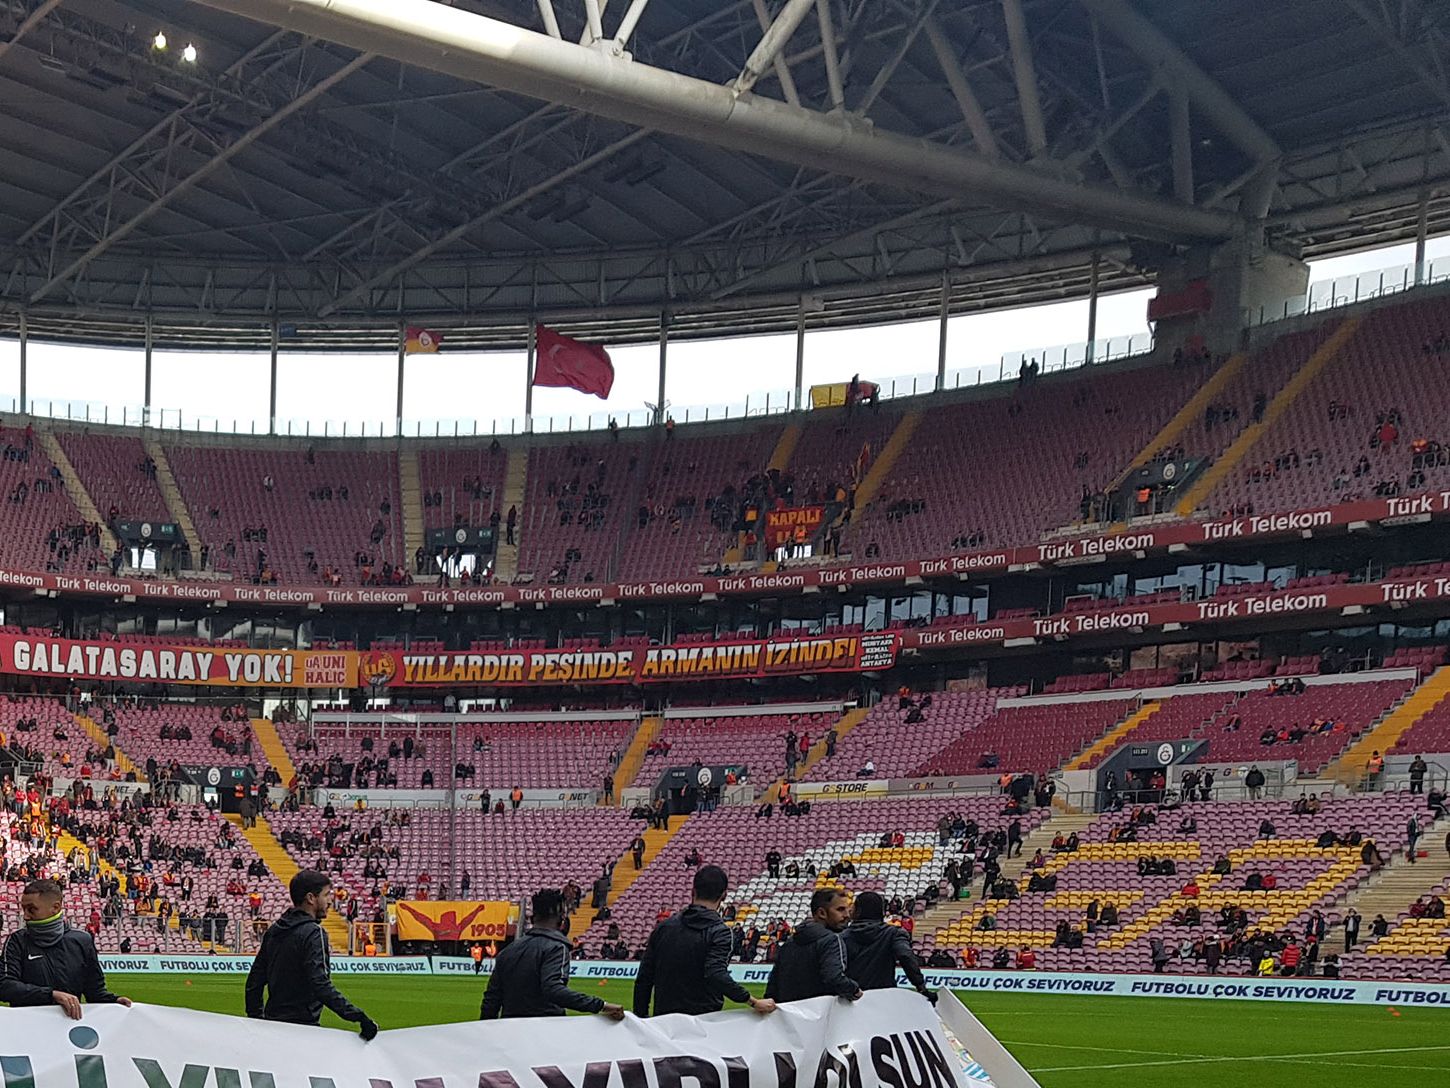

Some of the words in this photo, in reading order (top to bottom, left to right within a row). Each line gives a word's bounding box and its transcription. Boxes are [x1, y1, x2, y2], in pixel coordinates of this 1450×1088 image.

[1386, 494, 1434, 517] Türk
[1202, 519, 1242, 541] Türk
[1249, 510, 1332, 534] Telekom
[1038, 542, 1074, 561] Türk
[1080, 533, 1154, 556] Telekom
[919, 559, 947, 573] Türk
[951, 553, 1007, 571] Telekom
[819, 569, 848, 583] Türk
[850, 564, 905, 581] Telekom
[55, 576, 81, 590] Türk
[83, 578, 131, 594] Telekom
[143, 583, 169, 596] Türk
[171, 585, 221, 599] Telekom
[618, 583, 646, 597] Türk
[649, 581, 704, 595] Telekom
[718, 577, 746, 591] Türk
[749, 574, 805, 589] Telekom
[1381, 580, 1427, 601] Türk
[234, 587, 261, 600] Türk
[264, 589, 314, 602] Telekom
[327, 590, 353, 602] Türk
[356, 590, 408, 603] Telekom
[422, 590, 449, 603] Türk
[452, 589, 505, 602] Telekom
[518, 588, 546, 601] Türk
[549, 586, 603, 600] Telekom
[1198, 600, 1238, 620] Türk
[1244, 592, 1327, 614] Telekom
[1034, 618, 1070, 635] Türk
[1076, 610, 1150, 632] Telekom
[918, 630, 945, 645] Türk
[949, 625, 1005, 642] Telekom
[13, 640, 213, 681] GALATASARAY
[224, 652, 294, 683] YOK!
[402, 654, 525, 683] YILLARDIR
[642, 642, 762, 676] ARMANIN
[470, 923, 506, 938] 1905
[160, 960, 209, 971] FUTBOLU
[211, 961, 234, 973] ÇOK
[350, 962, 371, 973] ÇOK
[993, 977, 1024, 990] ÇOK
[1131, 981, 1210, 995] FUTBOLU
[1213, 983, 1249, 998] ÇOK
[1375, 989, 1450, 1004] FUTBOL
